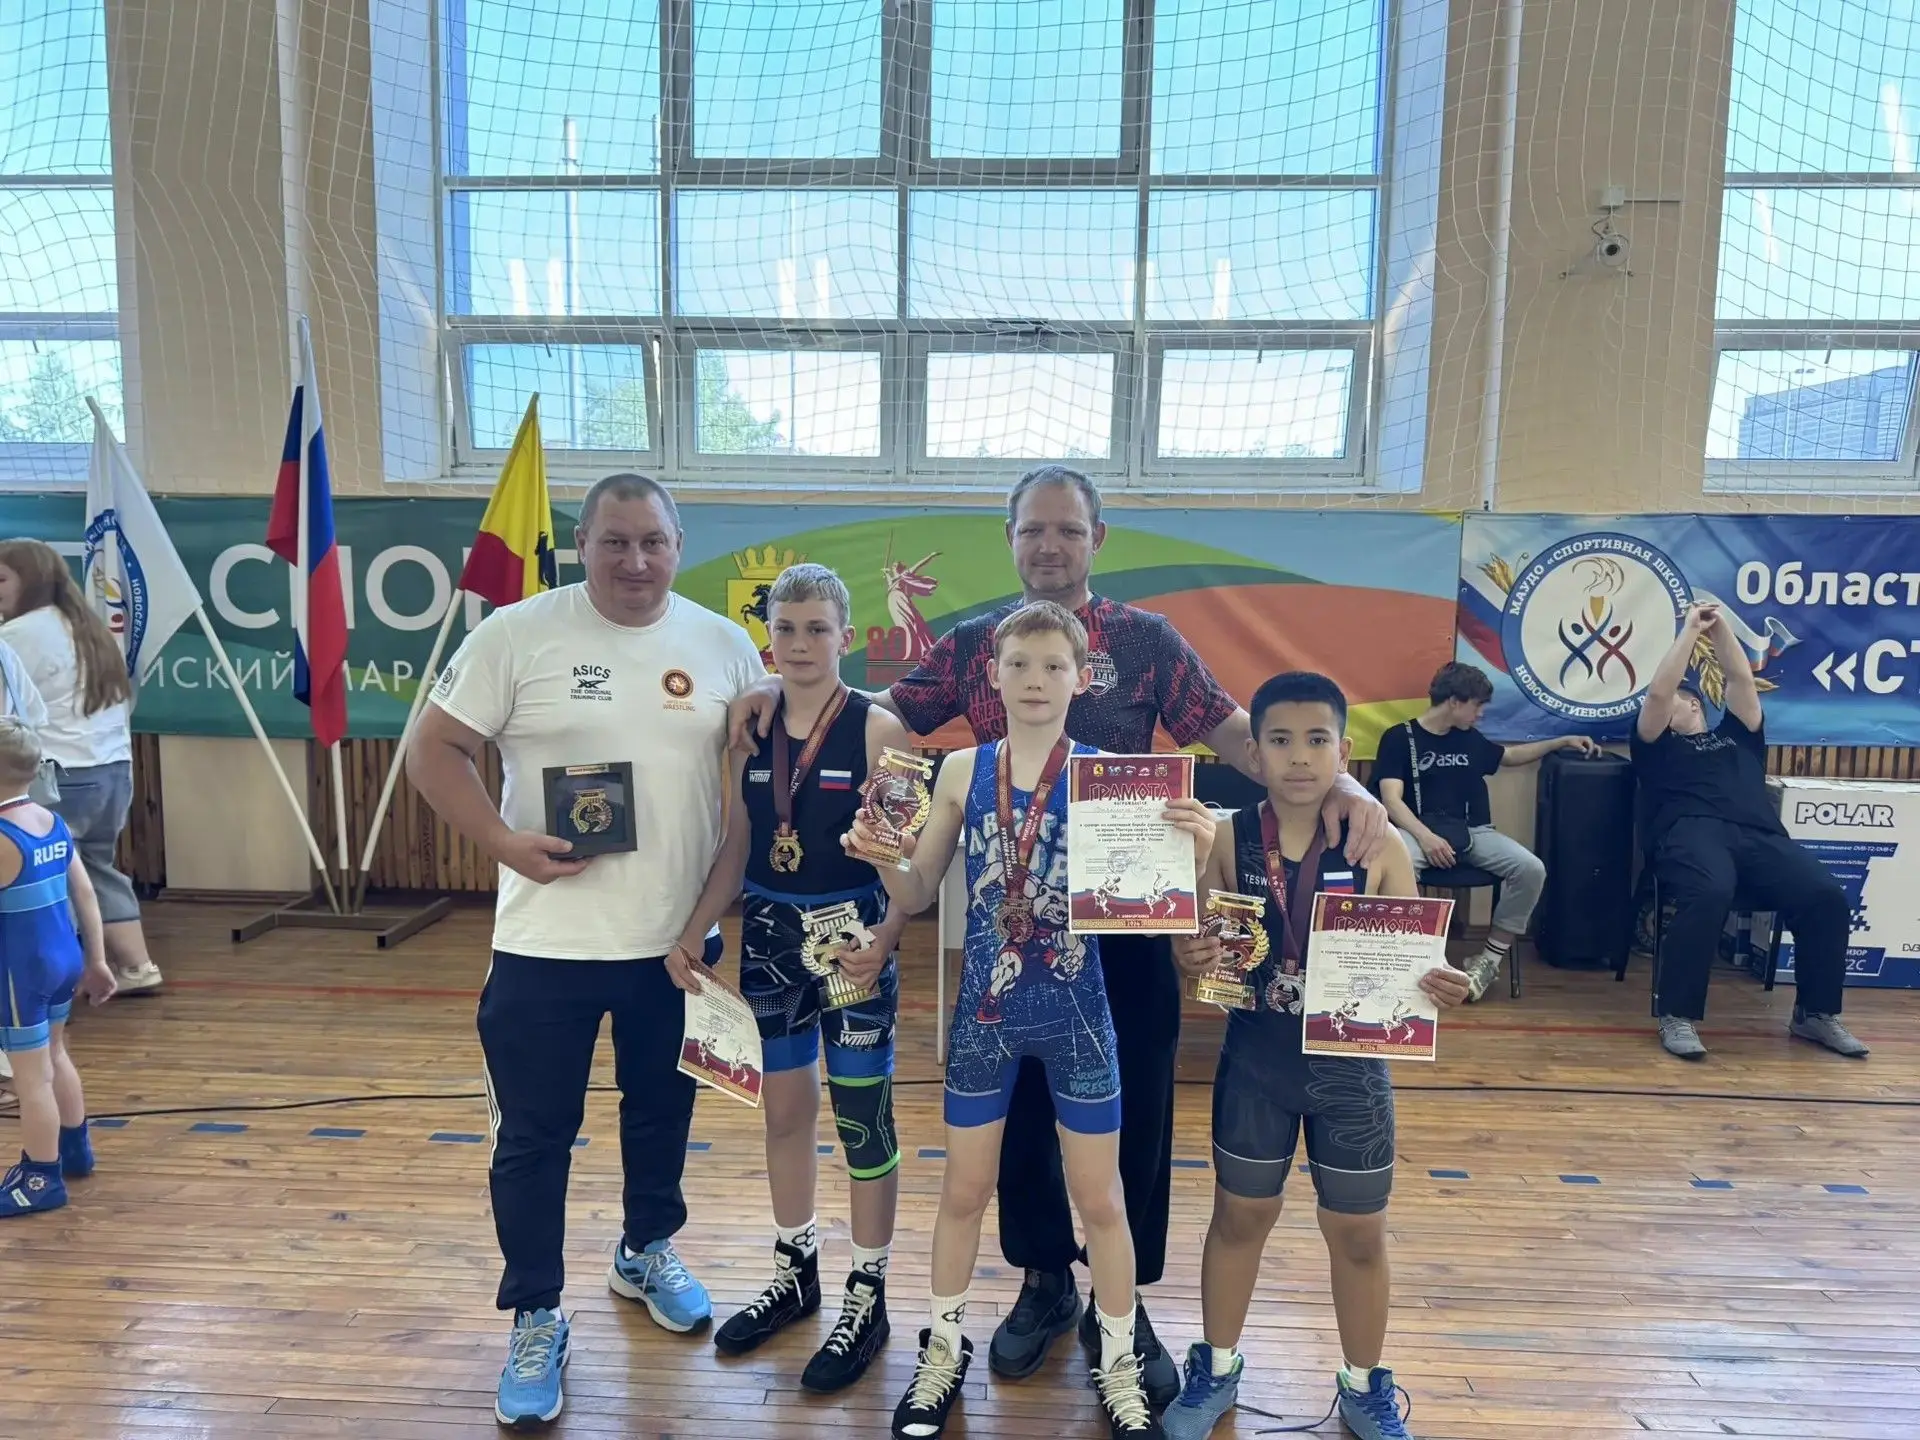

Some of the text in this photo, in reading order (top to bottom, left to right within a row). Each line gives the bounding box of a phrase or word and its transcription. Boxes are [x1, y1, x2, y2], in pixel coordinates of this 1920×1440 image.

[1509, 564, 1545, 616] МАУДО
[1547, 538, 1653, 566] «СПОРТИВНАЯ
[573, 664, 611, 679] ASICS
[1515, 664, 1637, 718] НОВОСЕРГИЕВСКИЙ
[1436, 753, 1469, 767] asics
[1088, 782, 1172, 801] ГРАМОТА
[1795, 801, 1894, 828] POLAR
[34, 840, 68, 867] RUS
[1334, 916, 1423, 935] ГРАМОТА
